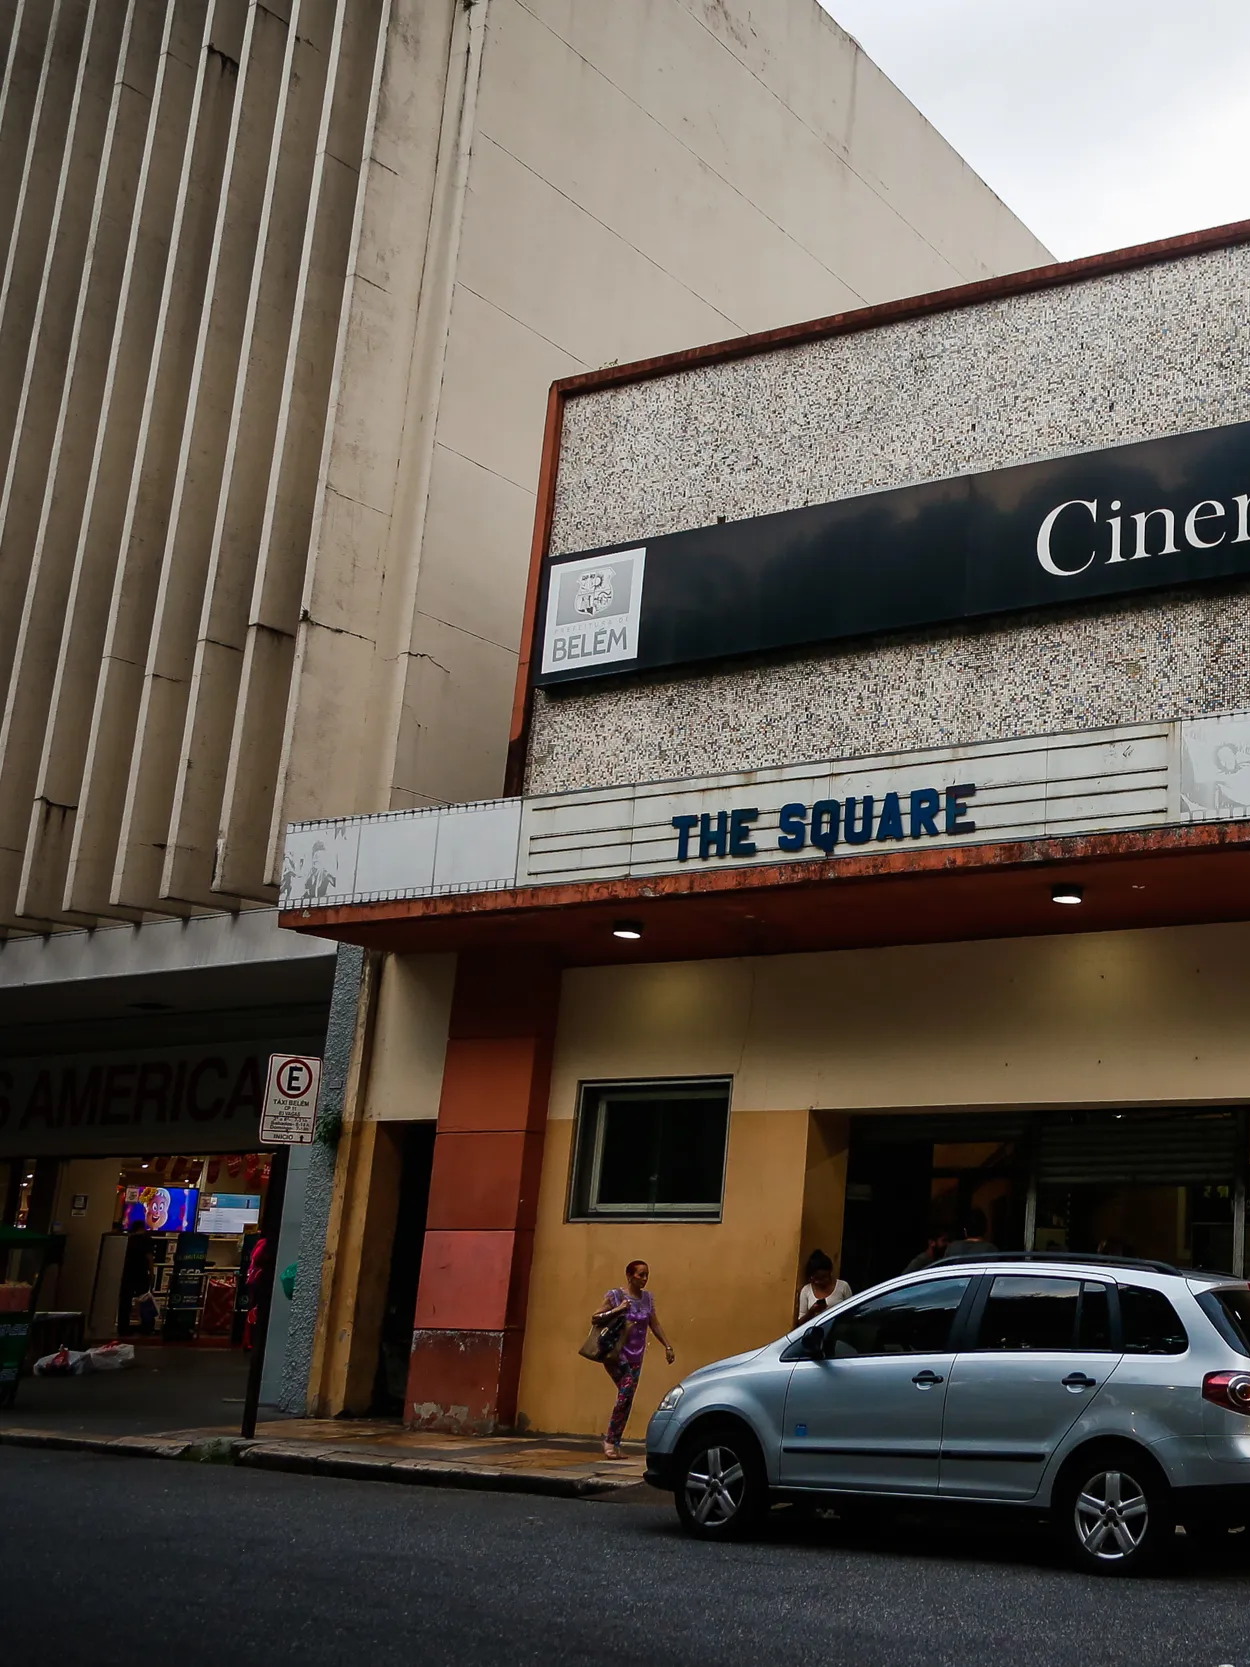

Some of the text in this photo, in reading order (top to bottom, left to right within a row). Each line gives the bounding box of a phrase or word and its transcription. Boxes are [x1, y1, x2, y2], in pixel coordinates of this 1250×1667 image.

[554, 620, 612, 634] PREFEITURA
[552, 626, 628, 662] BELÉM
[671, 783, 980, 862] THE SQUARE
[286, 1066, 303, 1091] E
